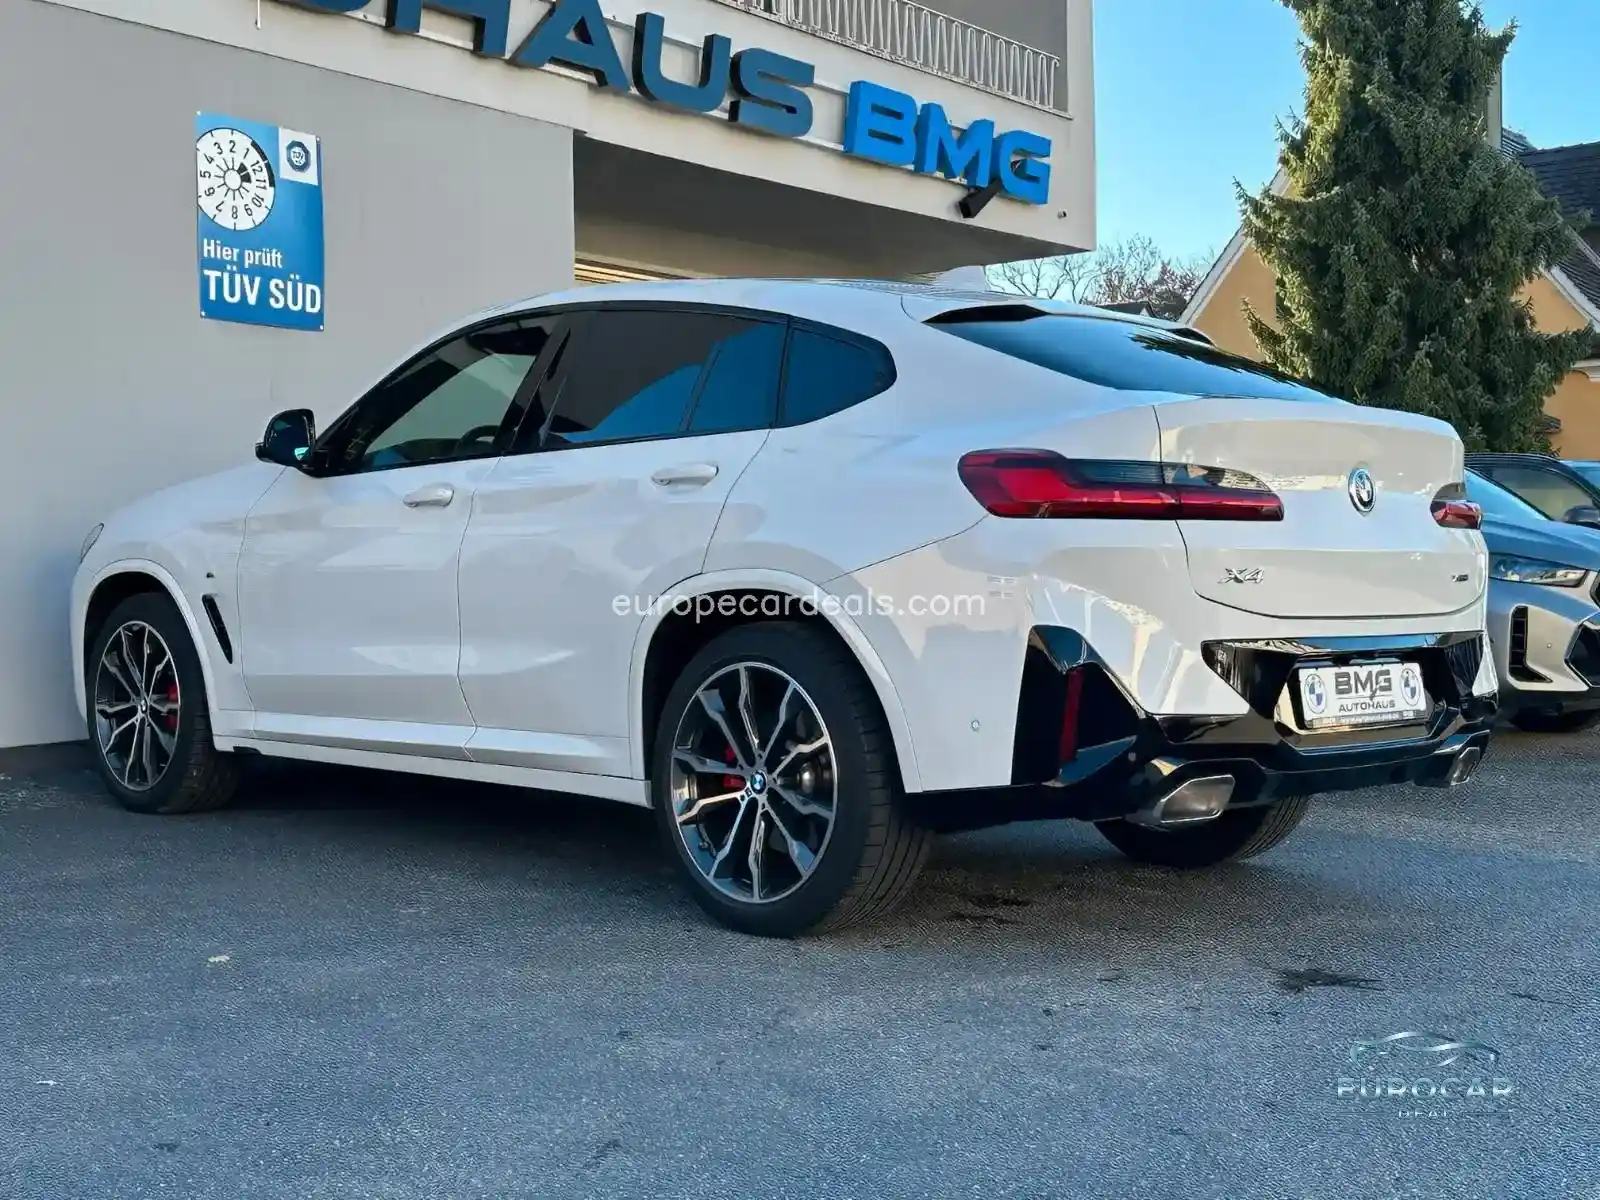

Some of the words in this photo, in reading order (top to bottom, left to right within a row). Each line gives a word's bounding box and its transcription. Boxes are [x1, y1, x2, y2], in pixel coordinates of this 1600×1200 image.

[275, 0, 815, 138] HAUS
[844, 80, 1053, 205] BMG
[213, 141, 224, 155] 3
[228, 139, 237, 154] 2
[242, 147, 250, 160] 1
[203, 152, 215, 165] 4
[199, 170, 212, 179] 5
[250, 160, 263, 175] 12
[255, 178, 268, 190] 11
[215, 200, 225, 213] 7
[251, 193, 265, 208] 10
[231, 204, 239, 220] 8
[203, 238, 240, 262] Hier
[244, 247, 283, 269] prüft
[203, 264, 261, 306] TÜV
[269, 273, 322, 313] SÜD
[1218, 567, 1264, 584] X4
[1335, 669, 1393, 698] BMG
[1339, 700, 1396, 713] AUTOHAUS
